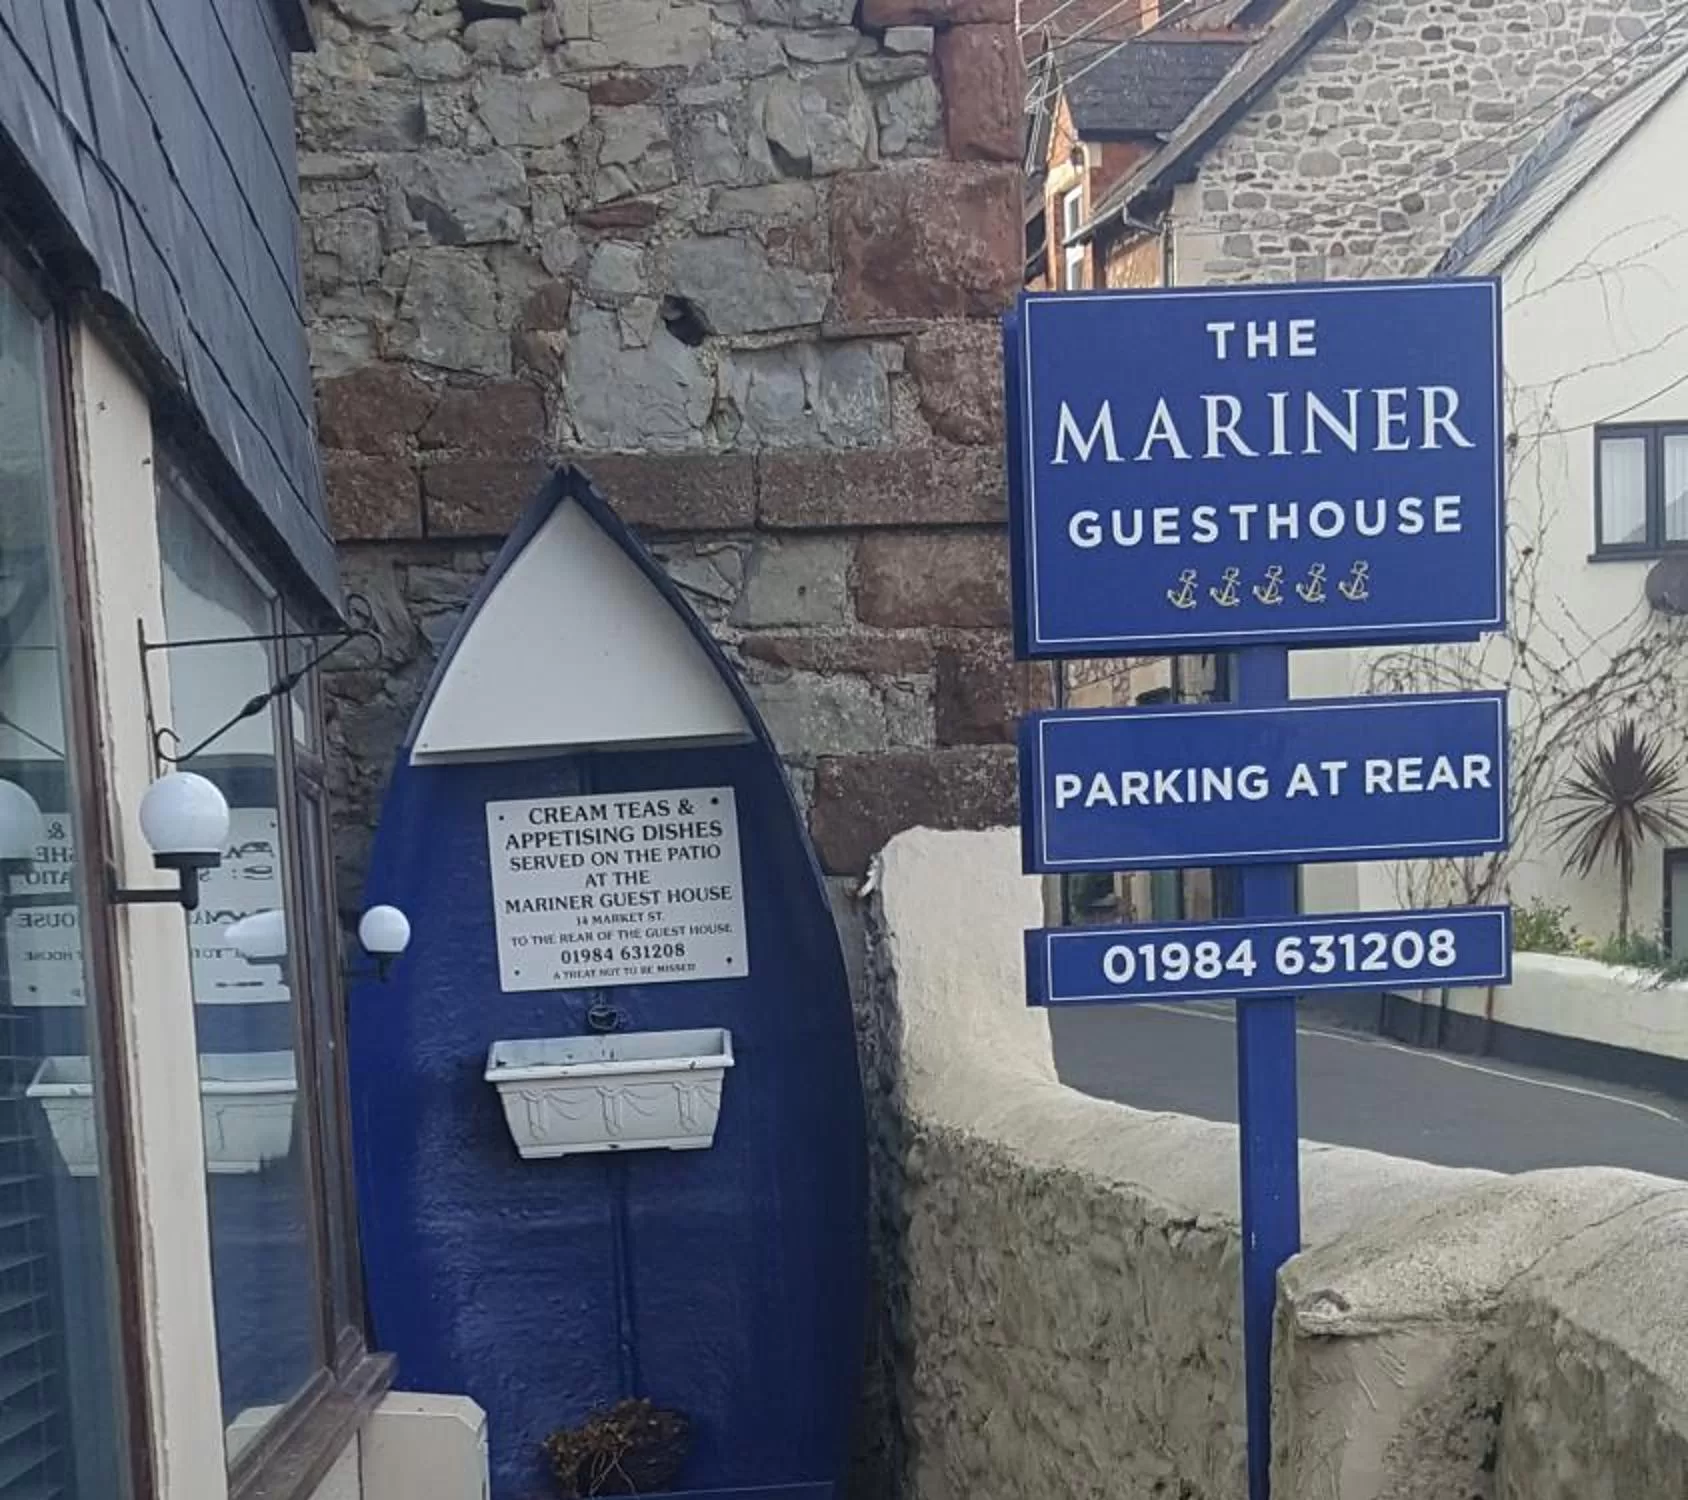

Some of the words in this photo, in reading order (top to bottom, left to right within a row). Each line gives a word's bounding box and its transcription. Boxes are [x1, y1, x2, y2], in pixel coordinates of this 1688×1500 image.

[1207, 319, 1317, 359] THE
[1051, 385, 1475, 465] MARINER
[1068, 495, 1463, 548] GUESTHOUSE
[1055, 765, 1269, 808] PARKING
[1286, 761, 1350, 799] AT
[1365, 754, 1491, 793] REAR
[528, 804, 608, 825] CREAM
[613, 799, 671, 820] TEAS
[678, 798, 695, 816] &
[505, 825, 634, 850] APPETISING
[642, 820, 723, 841] DISHES
[510, 853, 585, 872] SERVED
[591, 851, 619, 867] ON
[624, 848, 662, 865] THE
[667, 844, 721, 861] PATIO
[585, 873, 606, 889] AT
[612, 870, 650, 886] THE
[505, 895, 593, 914] MARINER
[599, 890, 662, 910] GUEST
[667, 886, 732, 903] HOUSE
[592, 912, 644, 925] MARKET
[511, 936, 528, 948] TO
[532, 933, 555, 946] THE
[559, 931, 593, 944] REAR
[597, 930, 613, 942] OF
[617, 928, 643, 940] THE
[645, 925, 686, 938] GUEST
[689, 923, 732, 935] HOUSE
[561, 947, 614, 965] 01984
[620, 943, 686, 960] 631208
[1103, 939, 1256, 983] 01984
[1275, 929, 1457, 974] 631208
